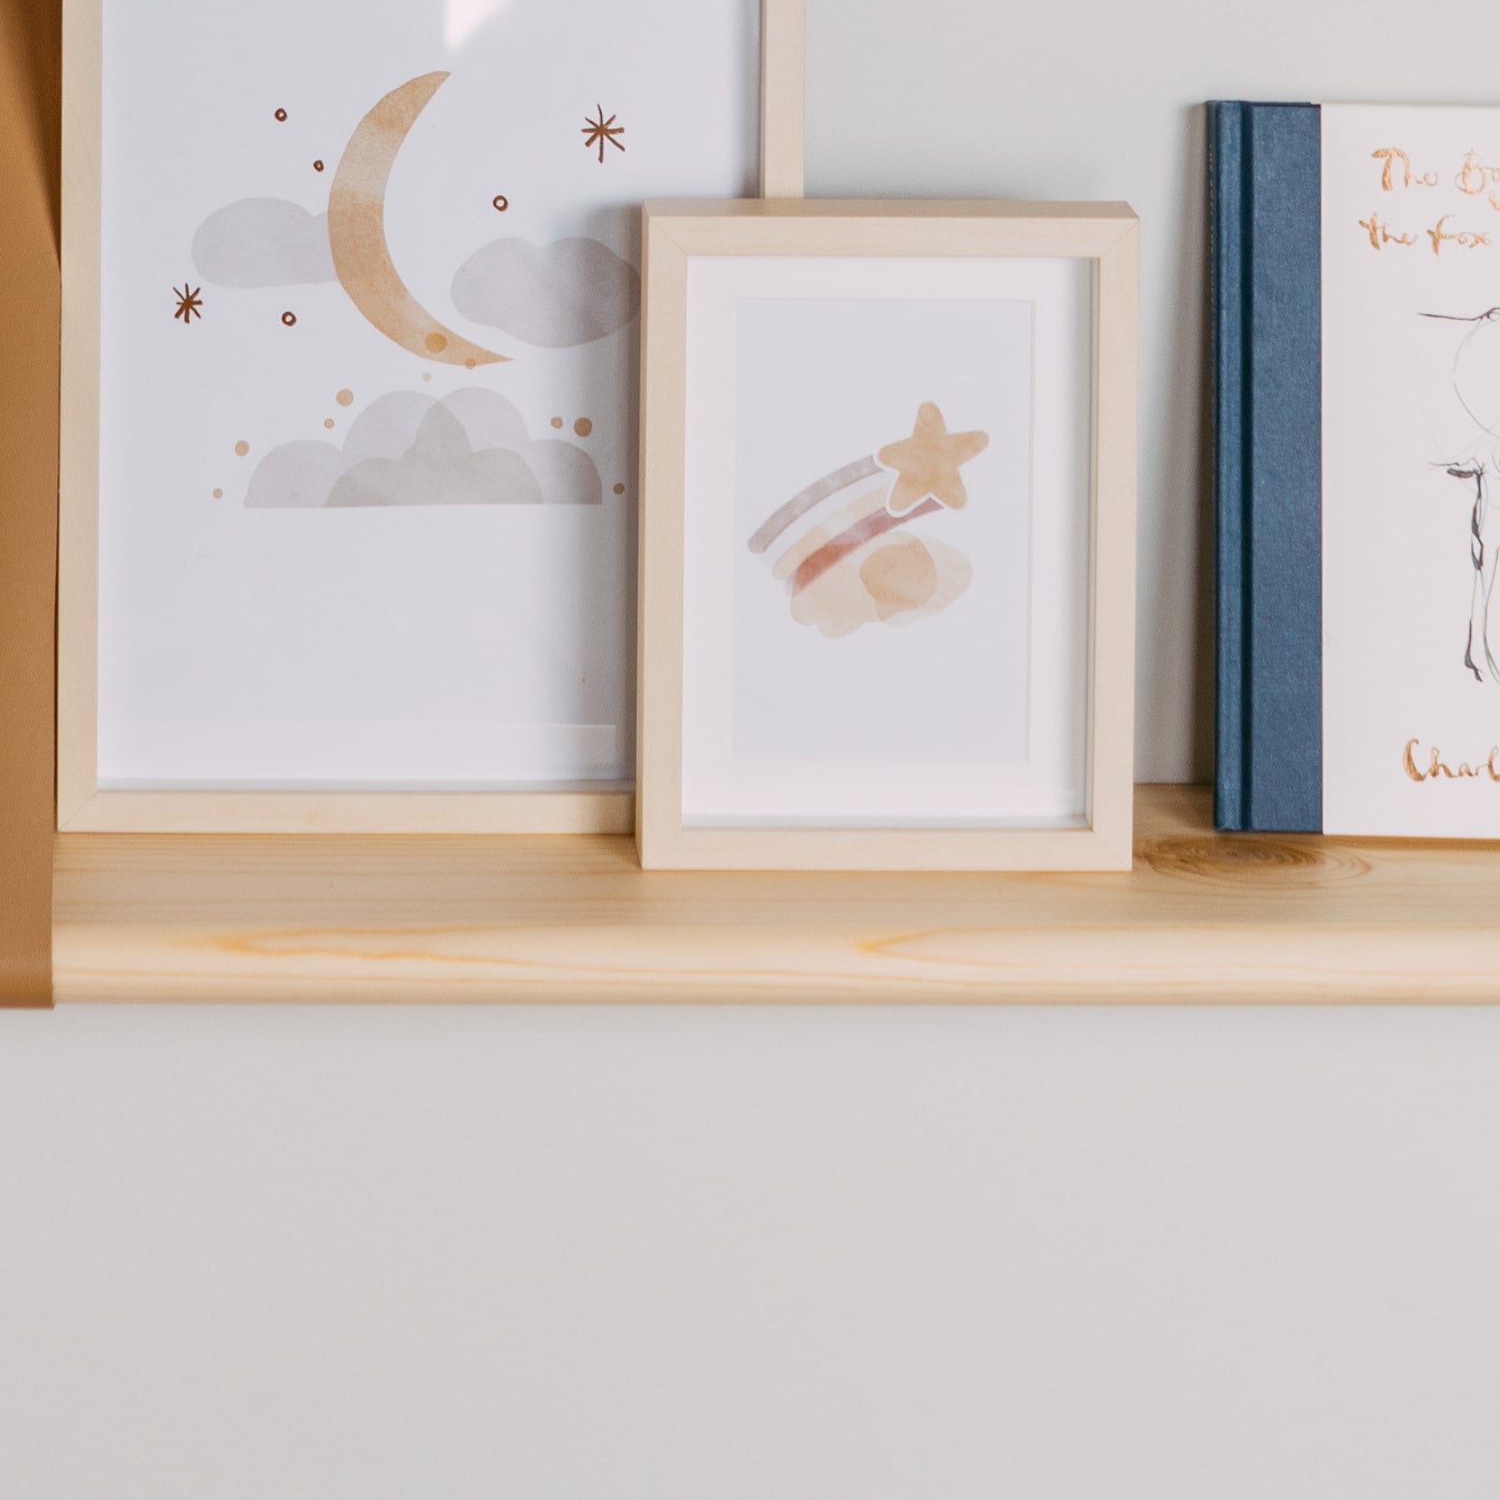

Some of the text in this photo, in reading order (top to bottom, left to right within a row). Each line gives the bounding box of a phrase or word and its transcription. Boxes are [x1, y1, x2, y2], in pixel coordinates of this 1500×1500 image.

[1371, 147, 1439, 192] The
[1358, 211, 1419, 251] the
[1427, 213, 1491, 257] fox
